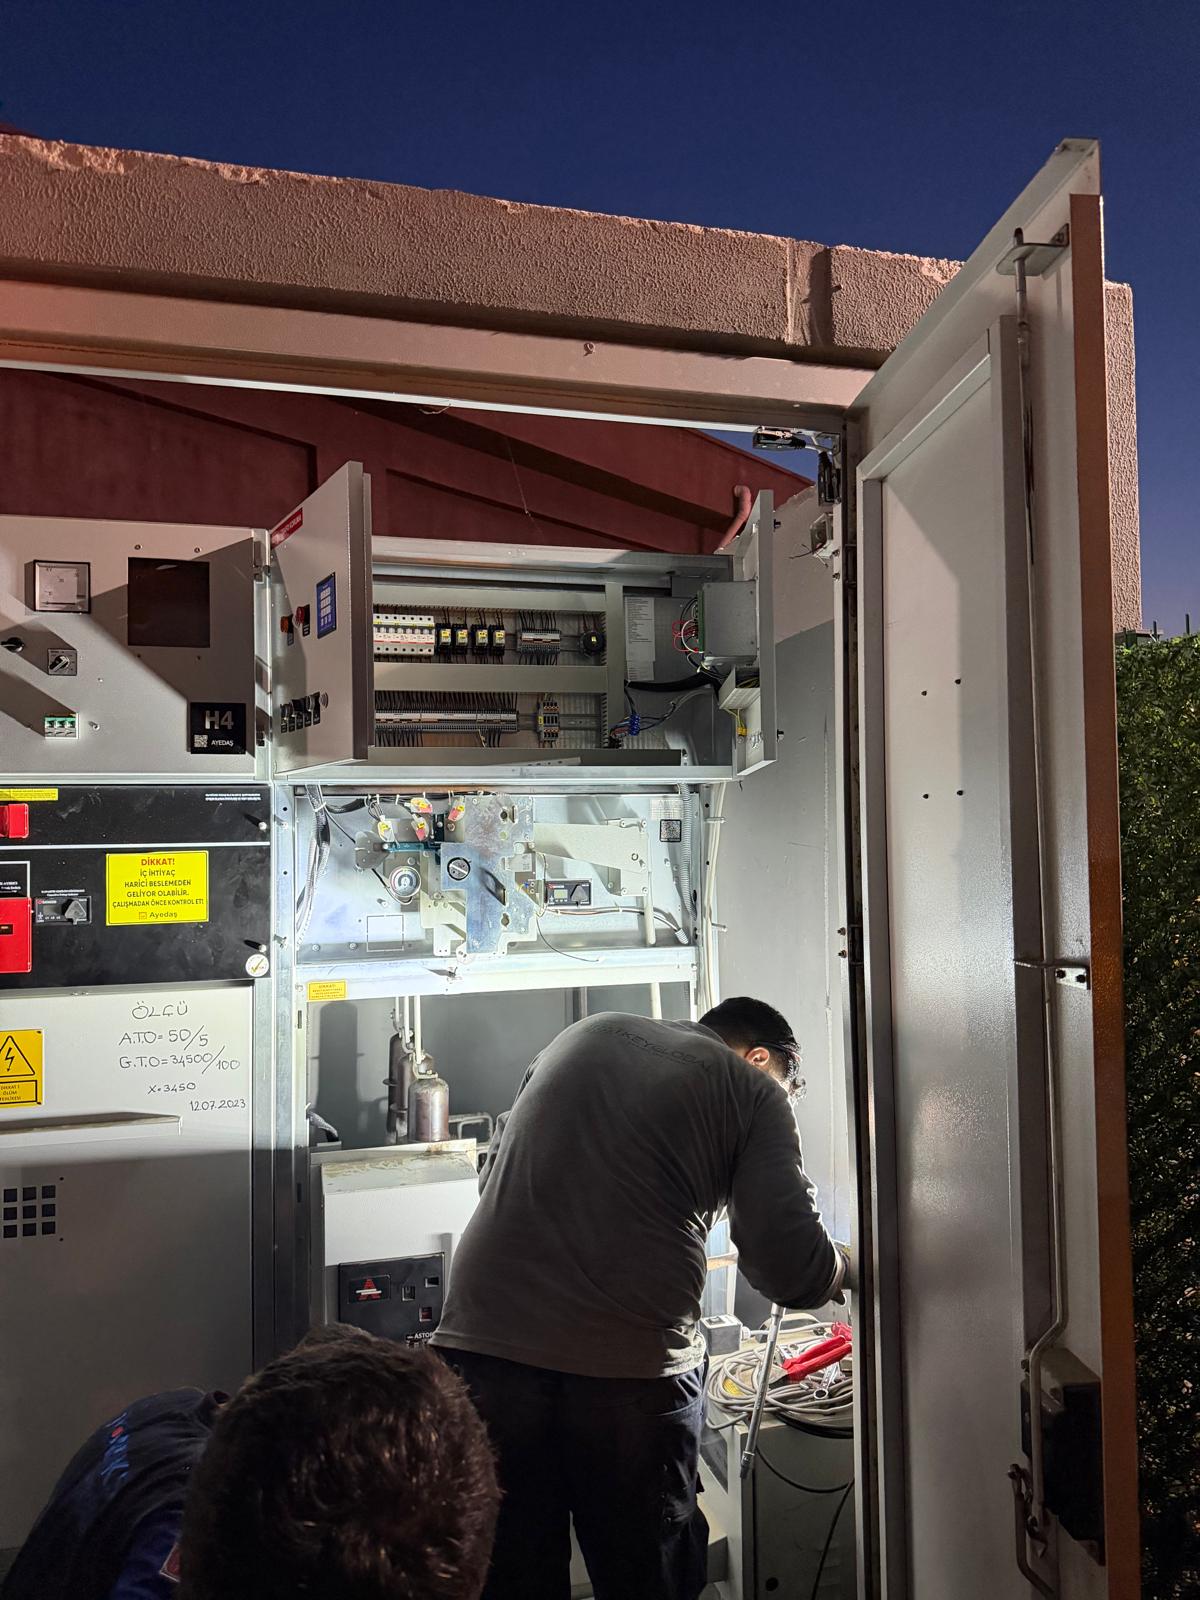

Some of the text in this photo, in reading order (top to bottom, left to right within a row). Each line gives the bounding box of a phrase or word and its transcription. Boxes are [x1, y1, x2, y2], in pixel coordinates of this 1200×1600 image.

[205, 710, 234, 730] H4
[141, 857, 175, 866] DİKKAT!
[149, 867, 176, 877] İHTİYAÇ
[124, 878, 192, 888] HARİCİ BESLEMEDEN
[127, 889, 156, 898] GELİYOR
[168, 898, 194, 906] KONTROL
